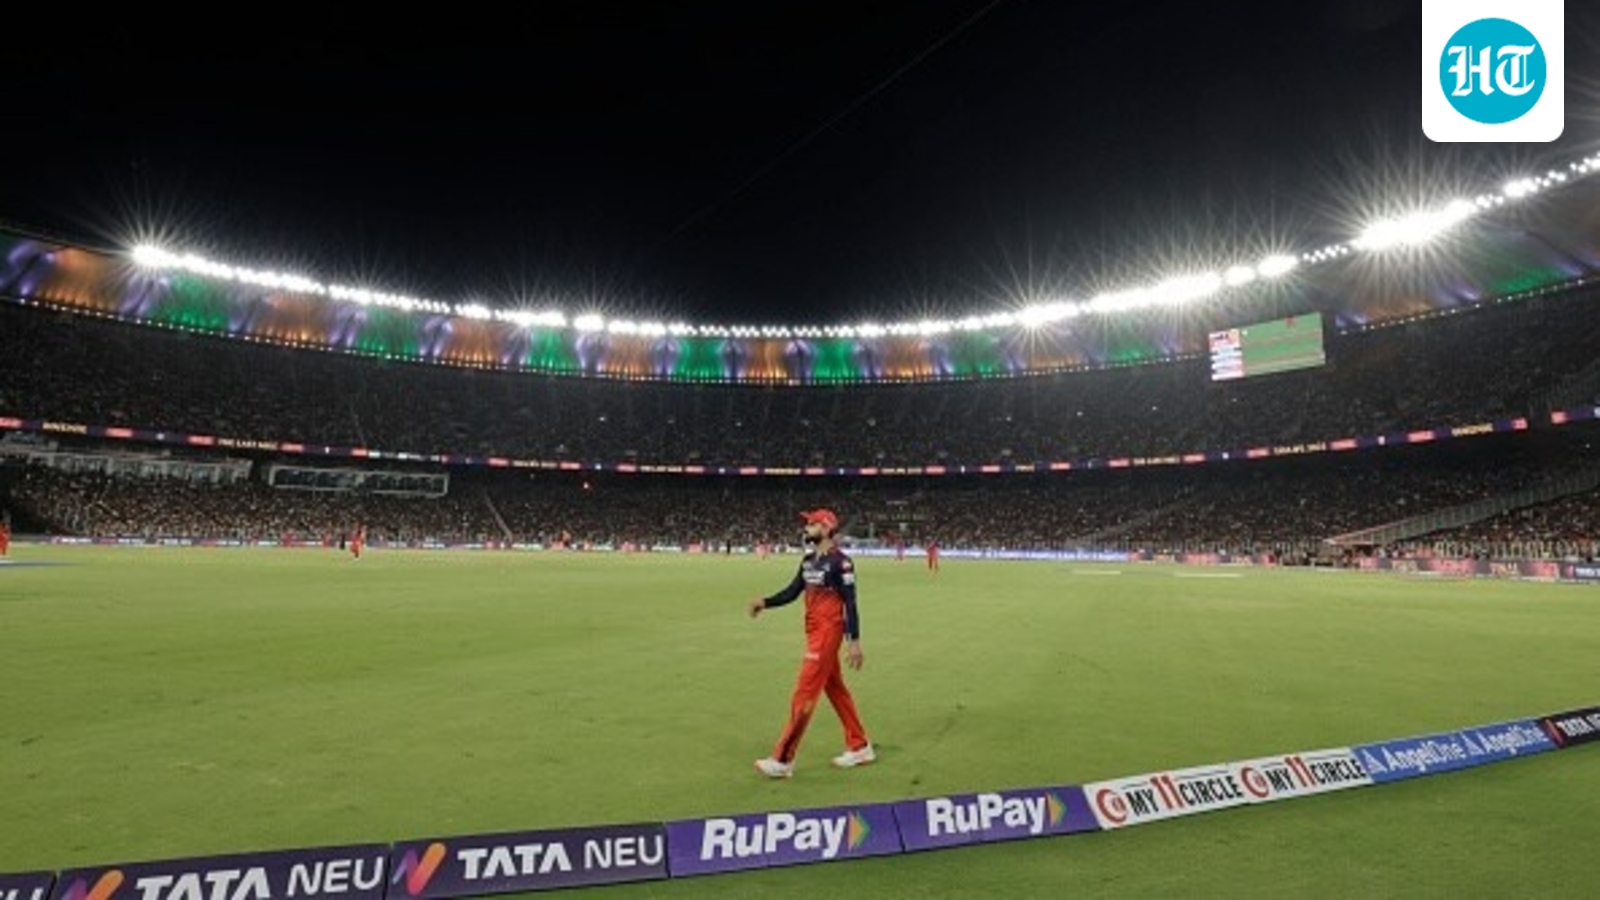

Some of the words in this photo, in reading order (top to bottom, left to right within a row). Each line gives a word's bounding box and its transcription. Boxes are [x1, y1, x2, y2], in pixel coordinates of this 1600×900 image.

[699, 812, 848, 860] RuPay
[926, 793, 1046, 837] RuPay
[135, 867, 271, 900] TATA
[286, 855, 384, 897] NEU
[457, 842, 573, 880] TATA
[583, 834, 664, 870] NEU
